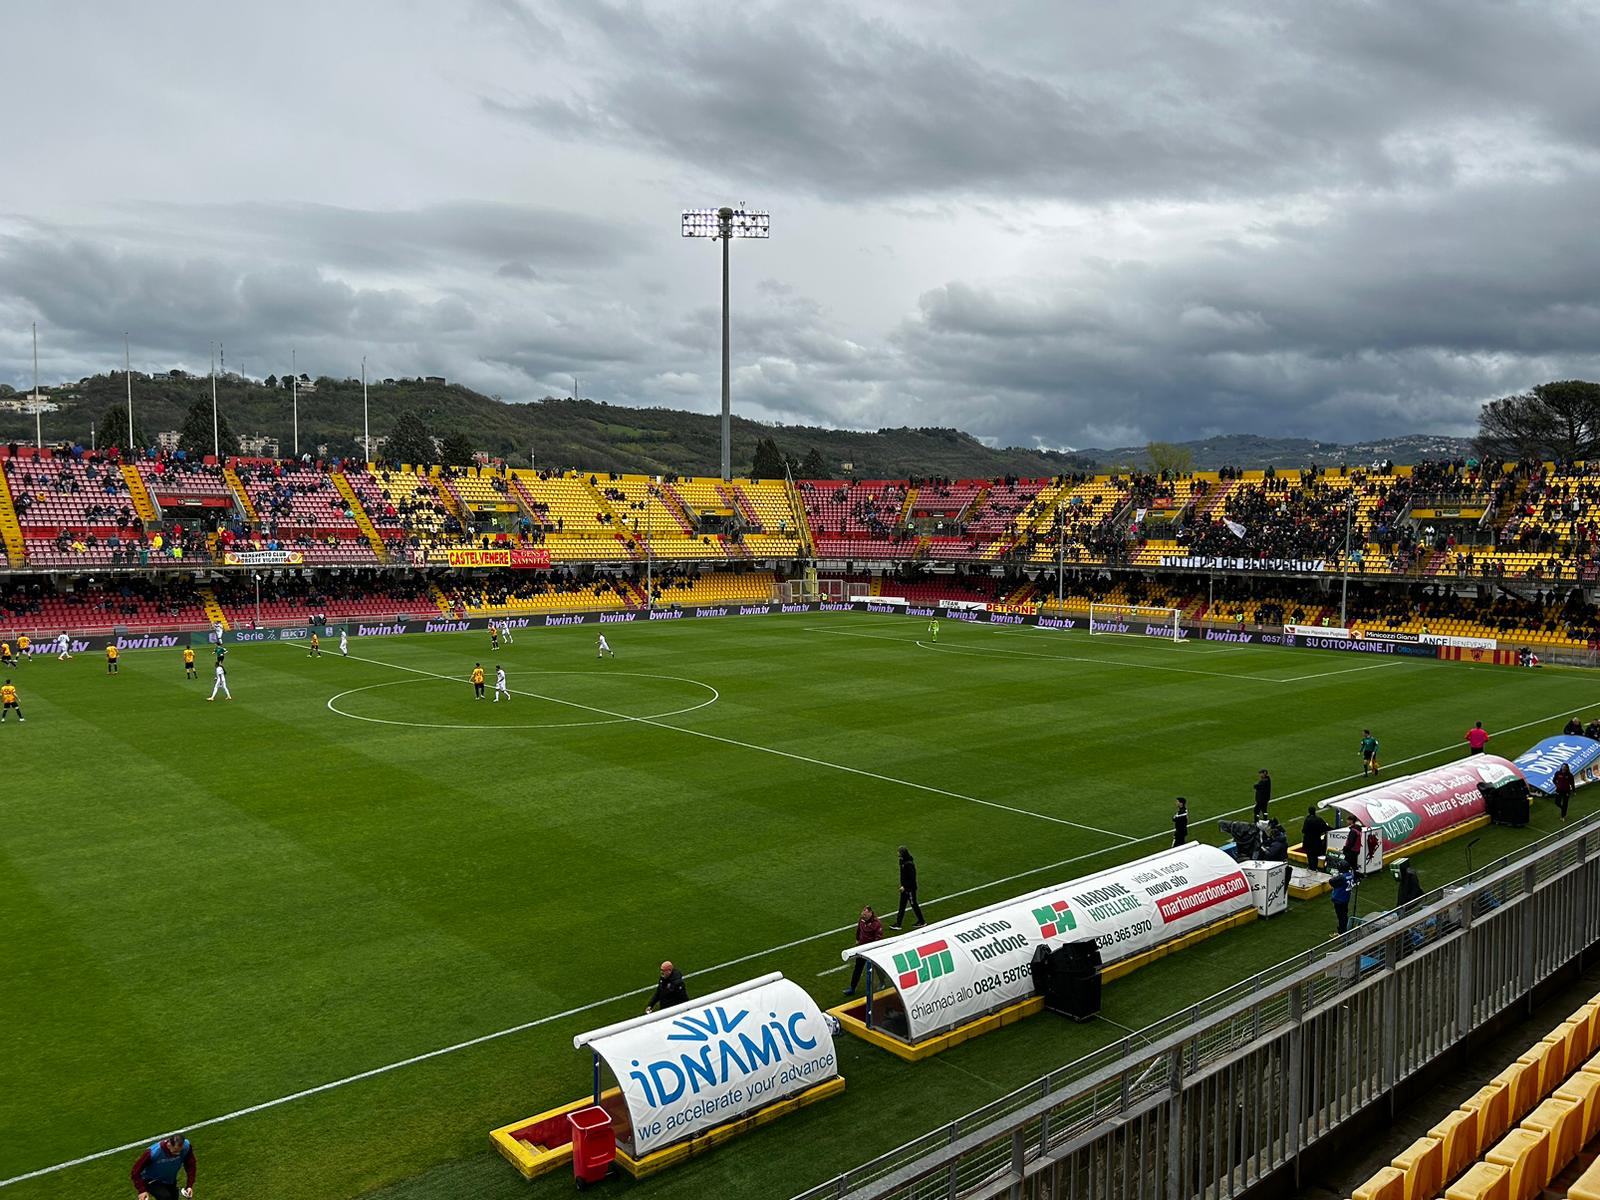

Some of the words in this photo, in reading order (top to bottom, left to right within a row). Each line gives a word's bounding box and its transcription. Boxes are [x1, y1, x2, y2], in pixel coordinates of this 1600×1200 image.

[449, 551, 509, 566] CASTELVENERE
[696, 606, 728, 617] bwin.tv
[740, 604, 770, 615] bwin.tv
[782, 603, 810, 612] bwin.tv
[819, 602, 854, 611] bwin.tv
[867, 603, 895, 613] bwin.tv
[905, 606, 935, 617] bwin.tv
[986, 603, 1037, 615] PETRONE
[545, 615, 585, 626] bwin.tv
[600, 611, 636, 623] bwin.tv
[650, 609, 683, 620] bwin.tv
[946, 608, 977, 620] bwin.tv
[990, 612, 1024, 624] bwin.tv
[425, 620, 469, 633] bwin.tv
[1038, 616, 1075, 628] bwin.tv
[1092, 620, 1129, 633] bwin.tv
[236, 631, 264, 641] Serie
[281, 629, 306, 639] BKT
[358, 623, 406, 636] bwin.tv
[1205, 629, 1252, 643] bwin.tv
[1366, 631, 1396, 639] Minicozzi
[1397, 633, 1418, 641] Gianni
[117, 635, 178, 649] bwin.tv
[1262, 634, 1281, 644] 00:57
[1306, 637, 1318, 647] SU
[1321, 639, 1395, 653] OTTOPAGINE.IT
[1424, 637, 1447, 646] ANCE
[1402, 787, 1428, 802] Dalla
[1425, 779, 1448, 797] Valle
[1422, 801, 1451, 818] Natura
[1456, 789, 1483, 807] Sapore
[1382, 815, 1414, 841] MAURO
[1131, 868, 1156, 884] visita
[1162, 861, 1189, 878] nostro
[1145, 879, 1173, 897] nuovo
[1173, 873, 1188, 888] sito
[1072, 882, 1131, 908] NARDONE
[1161, 876, 1245, 918] martinonardone.com
[1087, 894, 1142, 922] HOTELLERIE
[954, 918, 1012, 944] martino
[1095, 933, 1114, 950] 348
[1114, 927, 1131, 943] 365
[1131, 919, 1152, 936] 3970
[970, 933, 1029, 962] nardone
[911, 993, 956, 1020] chiamaci
[956, 987, 974, 1003] allo
[974, 977, 1002, 995] 0824
[638, 1121, 661, 1141] we
[666, 1088, 743, 1130] accelerate
[747, 1074, 777, 1102] your
[780, 1053, 834, 1084] advance
